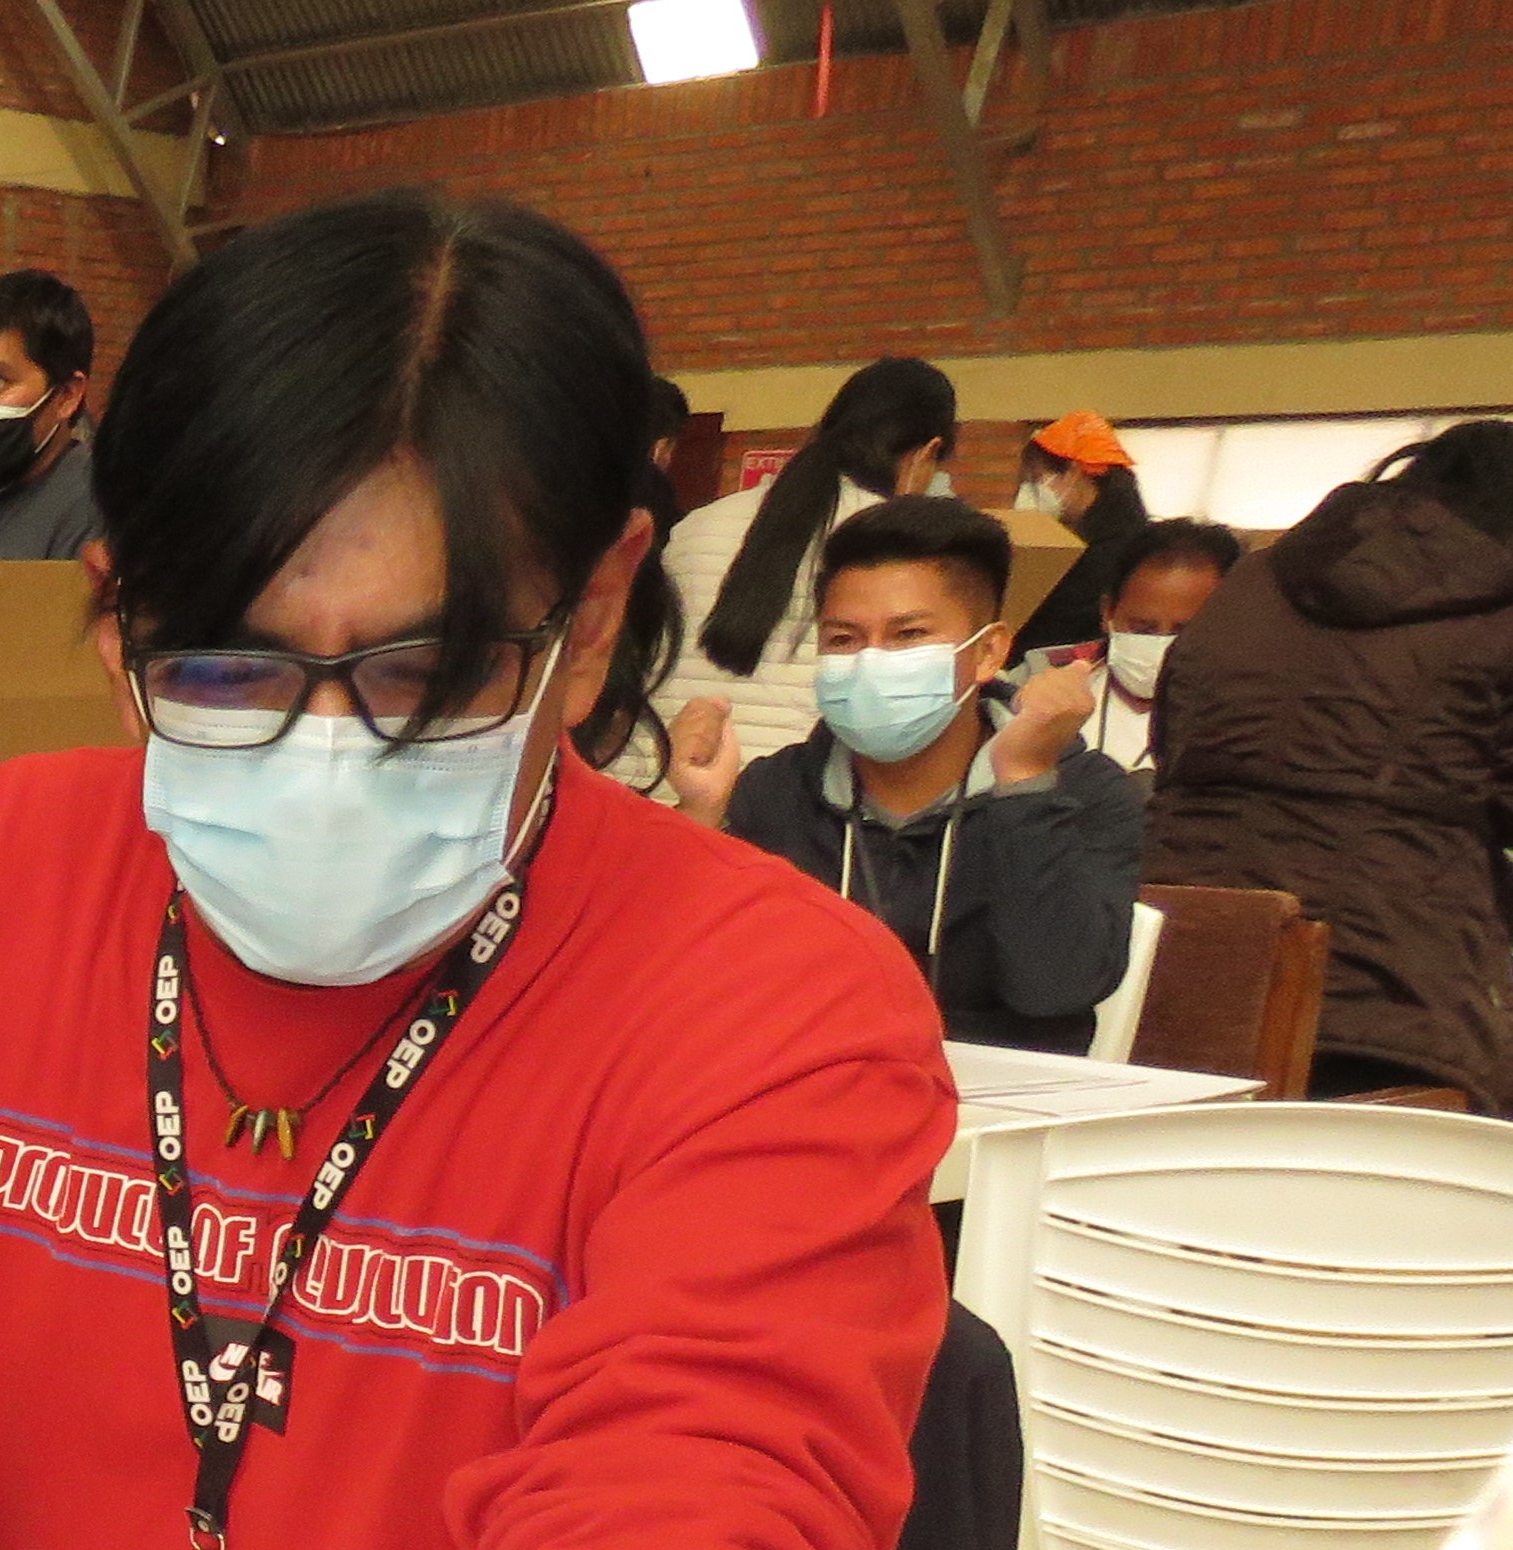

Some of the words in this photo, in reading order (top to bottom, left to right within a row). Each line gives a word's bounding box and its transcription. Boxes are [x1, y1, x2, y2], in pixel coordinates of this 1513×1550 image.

[468, 891, 521, 964] OEP
[155, 954, 179, 1024] OEP
[385, 1018, 436, 1089] OEP
[155, 1090, 181, 1160] OEP
[312, 1141, 357, 1211] OEP
[168, 1225, 193, 1296] OEP
[181, 1359, 213, 1426] OEP
[214, 1382, 249, 1443] OEP
